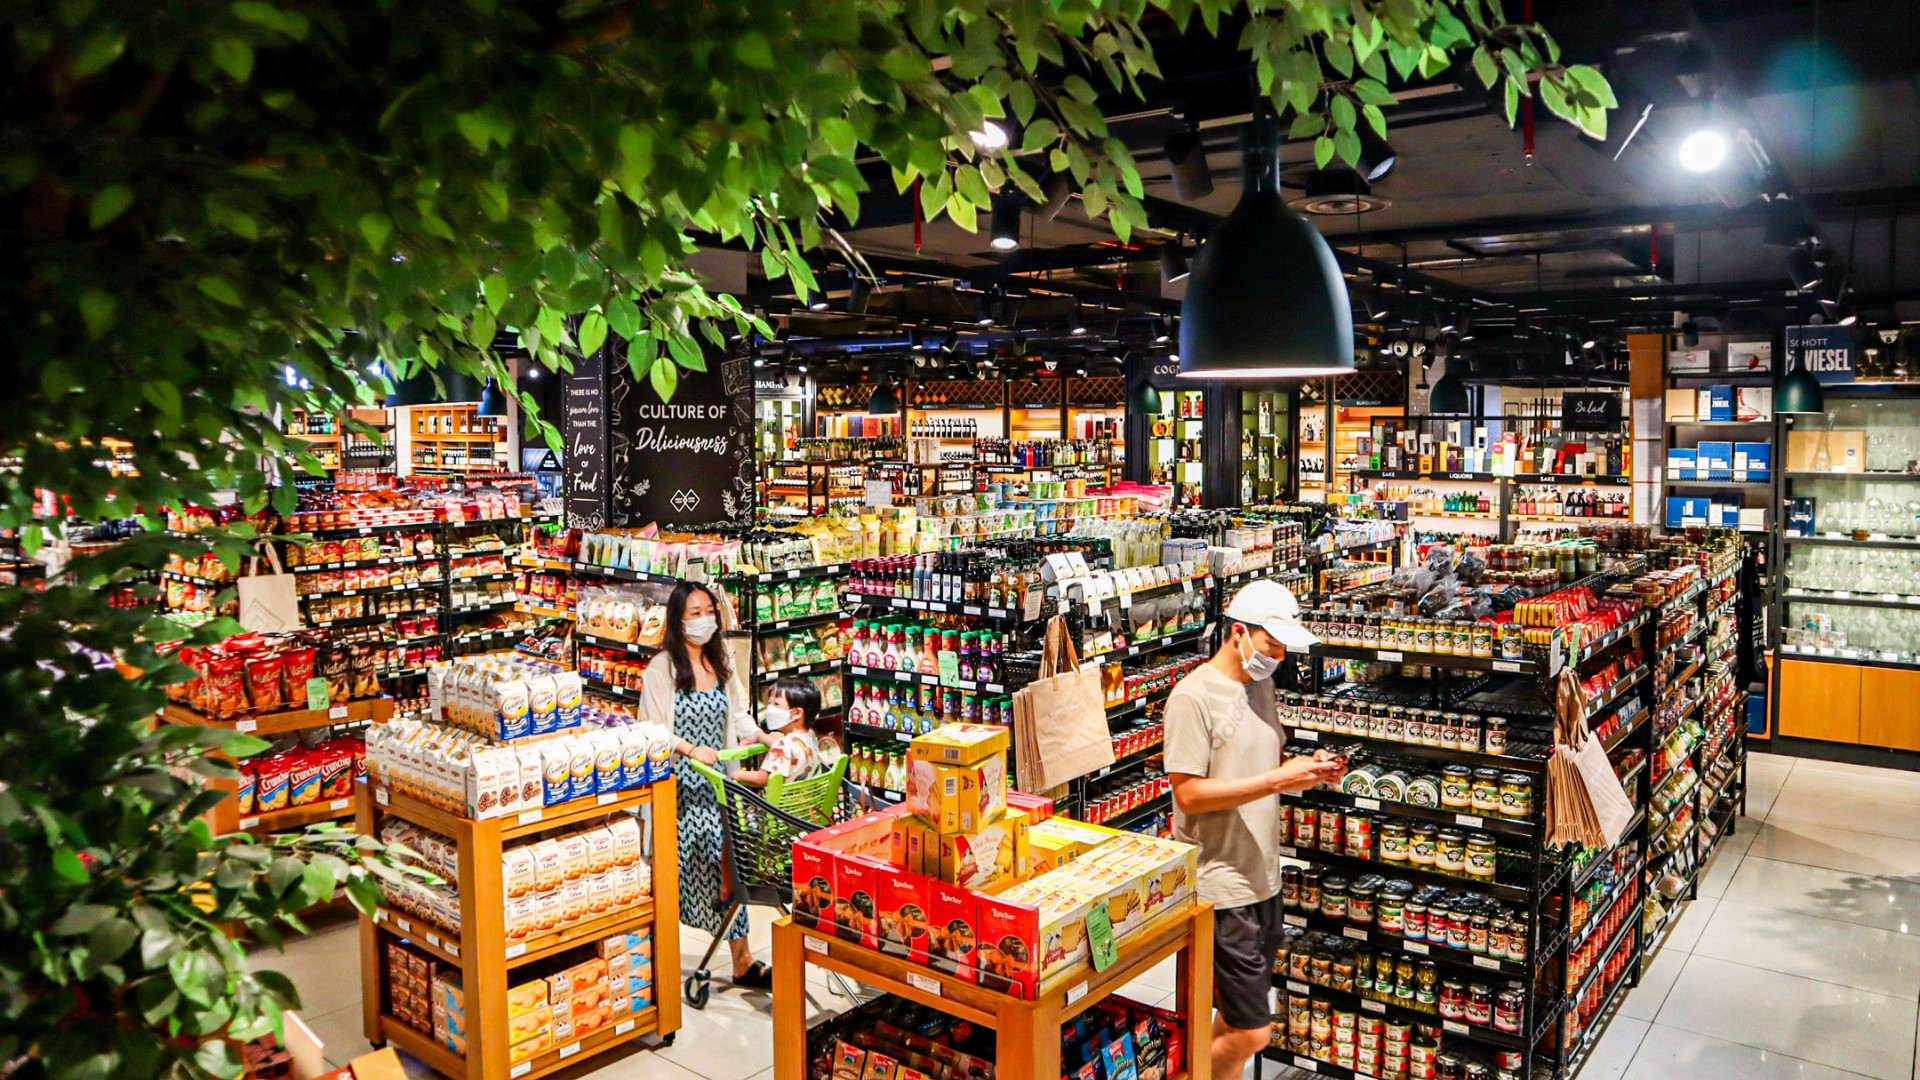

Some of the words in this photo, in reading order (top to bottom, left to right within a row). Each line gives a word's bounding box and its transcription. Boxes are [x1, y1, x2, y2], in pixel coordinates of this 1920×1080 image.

[587, 401, 599, 415] love
[639, 404, 705, 419] CULTURE
[708, 405, 727, 419] OF
[573, 432, 596, 458] love
[635, 425, 728, 455] Deliciousness
[573, 471, 598, 492] Food
